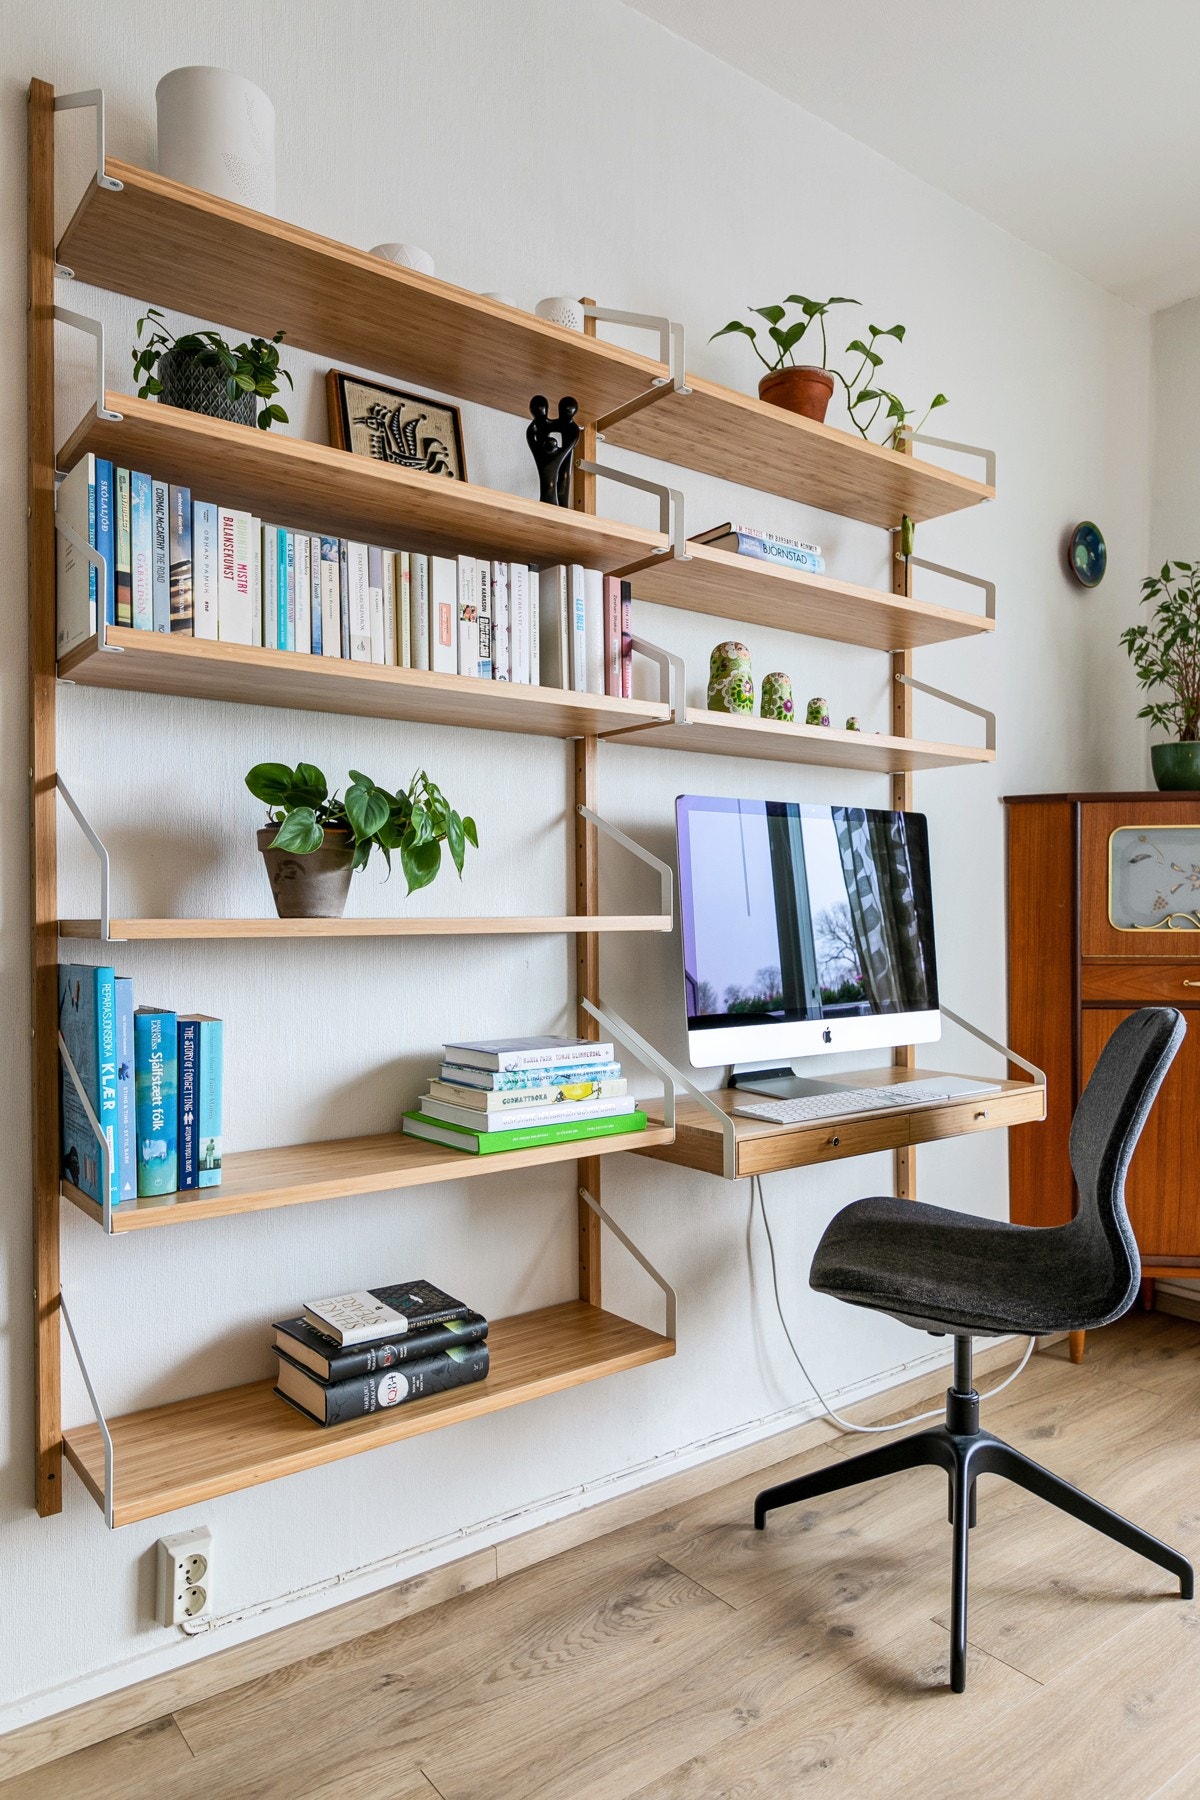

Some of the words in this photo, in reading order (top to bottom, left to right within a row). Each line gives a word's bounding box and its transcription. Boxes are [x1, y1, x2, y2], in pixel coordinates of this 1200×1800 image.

[100, 480, 109, 532] SKÓLALJÓÐ
[156, 488, 165, 515] CORMAC
[156, 516, 165, 550] McCARTHY
[237, 519, 248, 561] ROHINTON
[156, 553, 165, 565] THE
[223, 517, 234, 581] BALANSEKUNST
[137, 554, 146, 615] GABALDON
[156, 566, 165, 583] ROAD
[237, 563, 248, 594] MISTRY
[576, 598, 584, 612] LES
[576, 613, 584, 631] MEG
[102, 983, 113, 1057] REPARASJONSBOKA
[184, 1026, 194, 1039] THE
[184, 1041, 194, 1061] STORY
[101, 1063, 116, 1110] KLÆR
[150, 1052, 164, 1106] Sjálfstætt
[184, 1069, 194, 1111] FORGETTING
[502, 1094, 548, 1105] GODNATTBOKA
[152, 1109, 165, 1131] fólk
[313, 1300, 366, 1330] SHAKE
[334, 1296, 387, 1325] SPEARE
[387, 1374, 398, 1405] 1Q84
